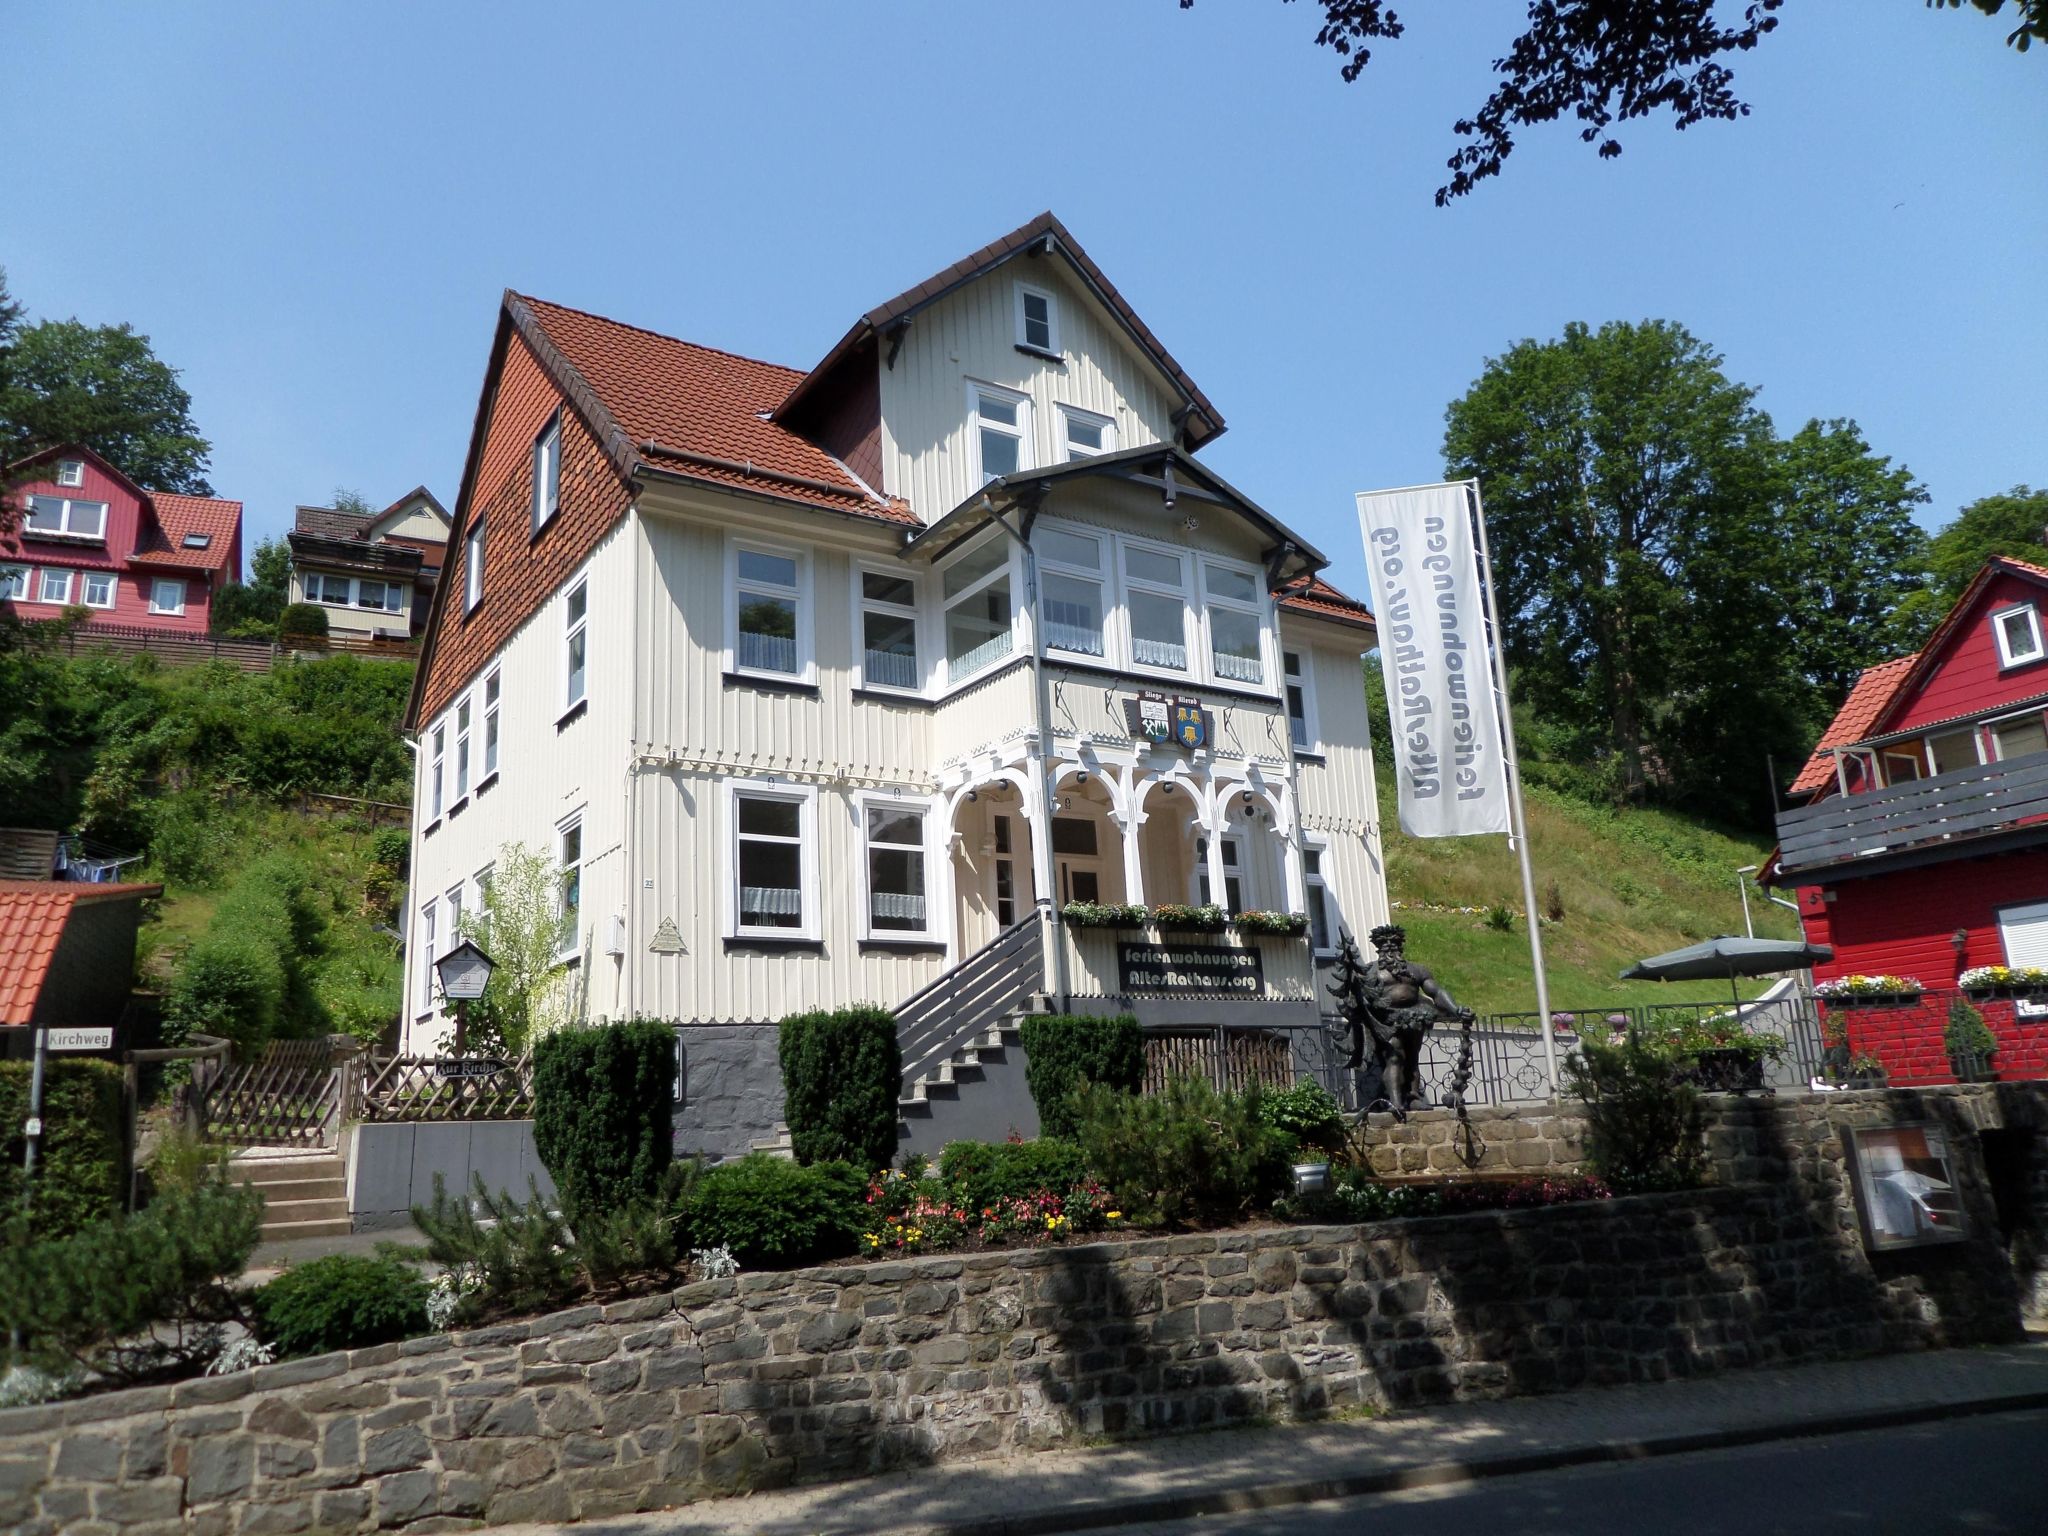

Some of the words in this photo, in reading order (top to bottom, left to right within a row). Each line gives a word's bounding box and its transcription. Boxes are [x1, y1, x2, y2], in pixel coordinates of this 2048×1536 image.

[1125, 949, 1256, 969] ferienwohnungen
[1129, 971, 1256, 990] AltesRathaus.org
[49, 1032, 109, 1047] Kirchweg
[438, 1062, 459, 1076] Zur
[462, 1061, 497, 1075] Kirche
